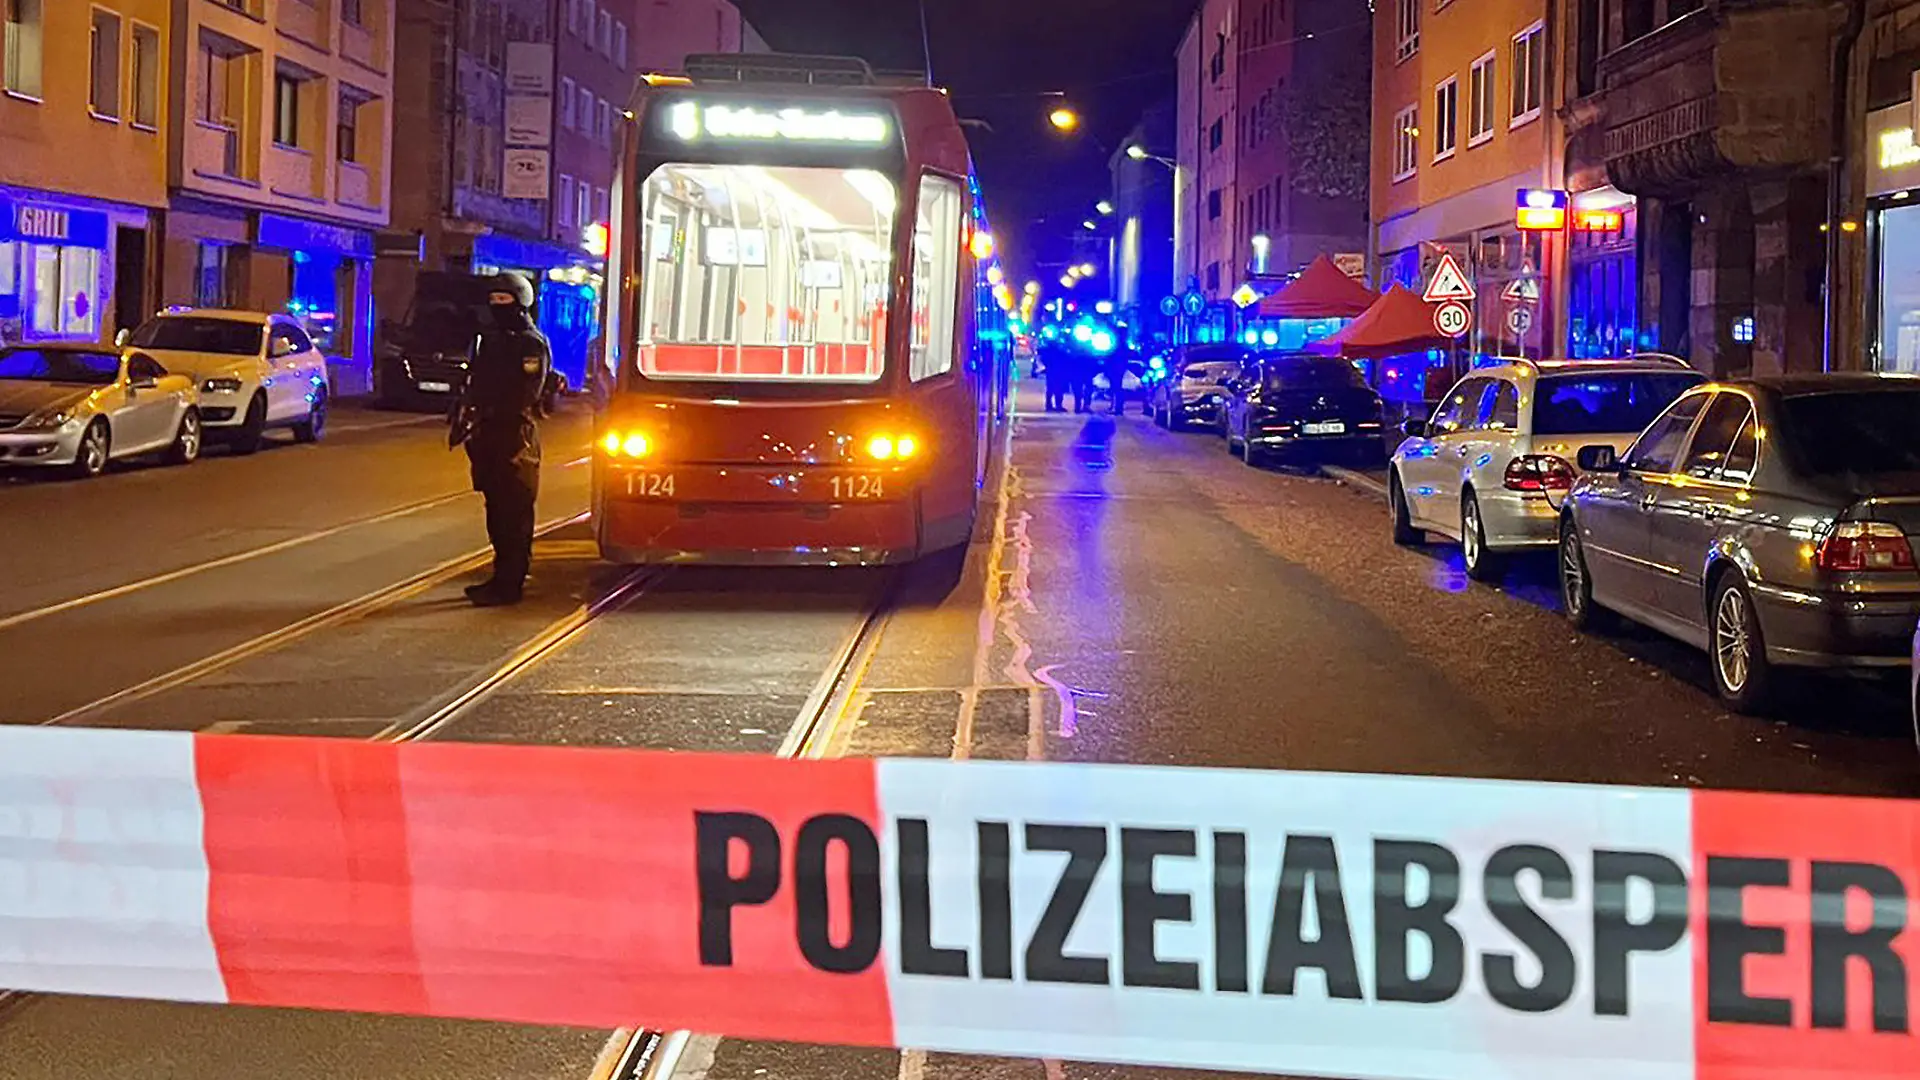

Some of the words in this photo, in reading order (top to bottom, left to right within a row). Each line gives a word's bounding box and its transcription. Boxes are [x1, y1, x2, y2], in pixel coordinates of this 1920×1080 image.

[21, 206, 68, 238] GRILL
[1442, 311, 1463, 328] 30
[625, 474, 675, 496] 1124
[830, 475, 884, 498] 1124
[693, 810, 1909, 1035] POLIZEIABSPER
